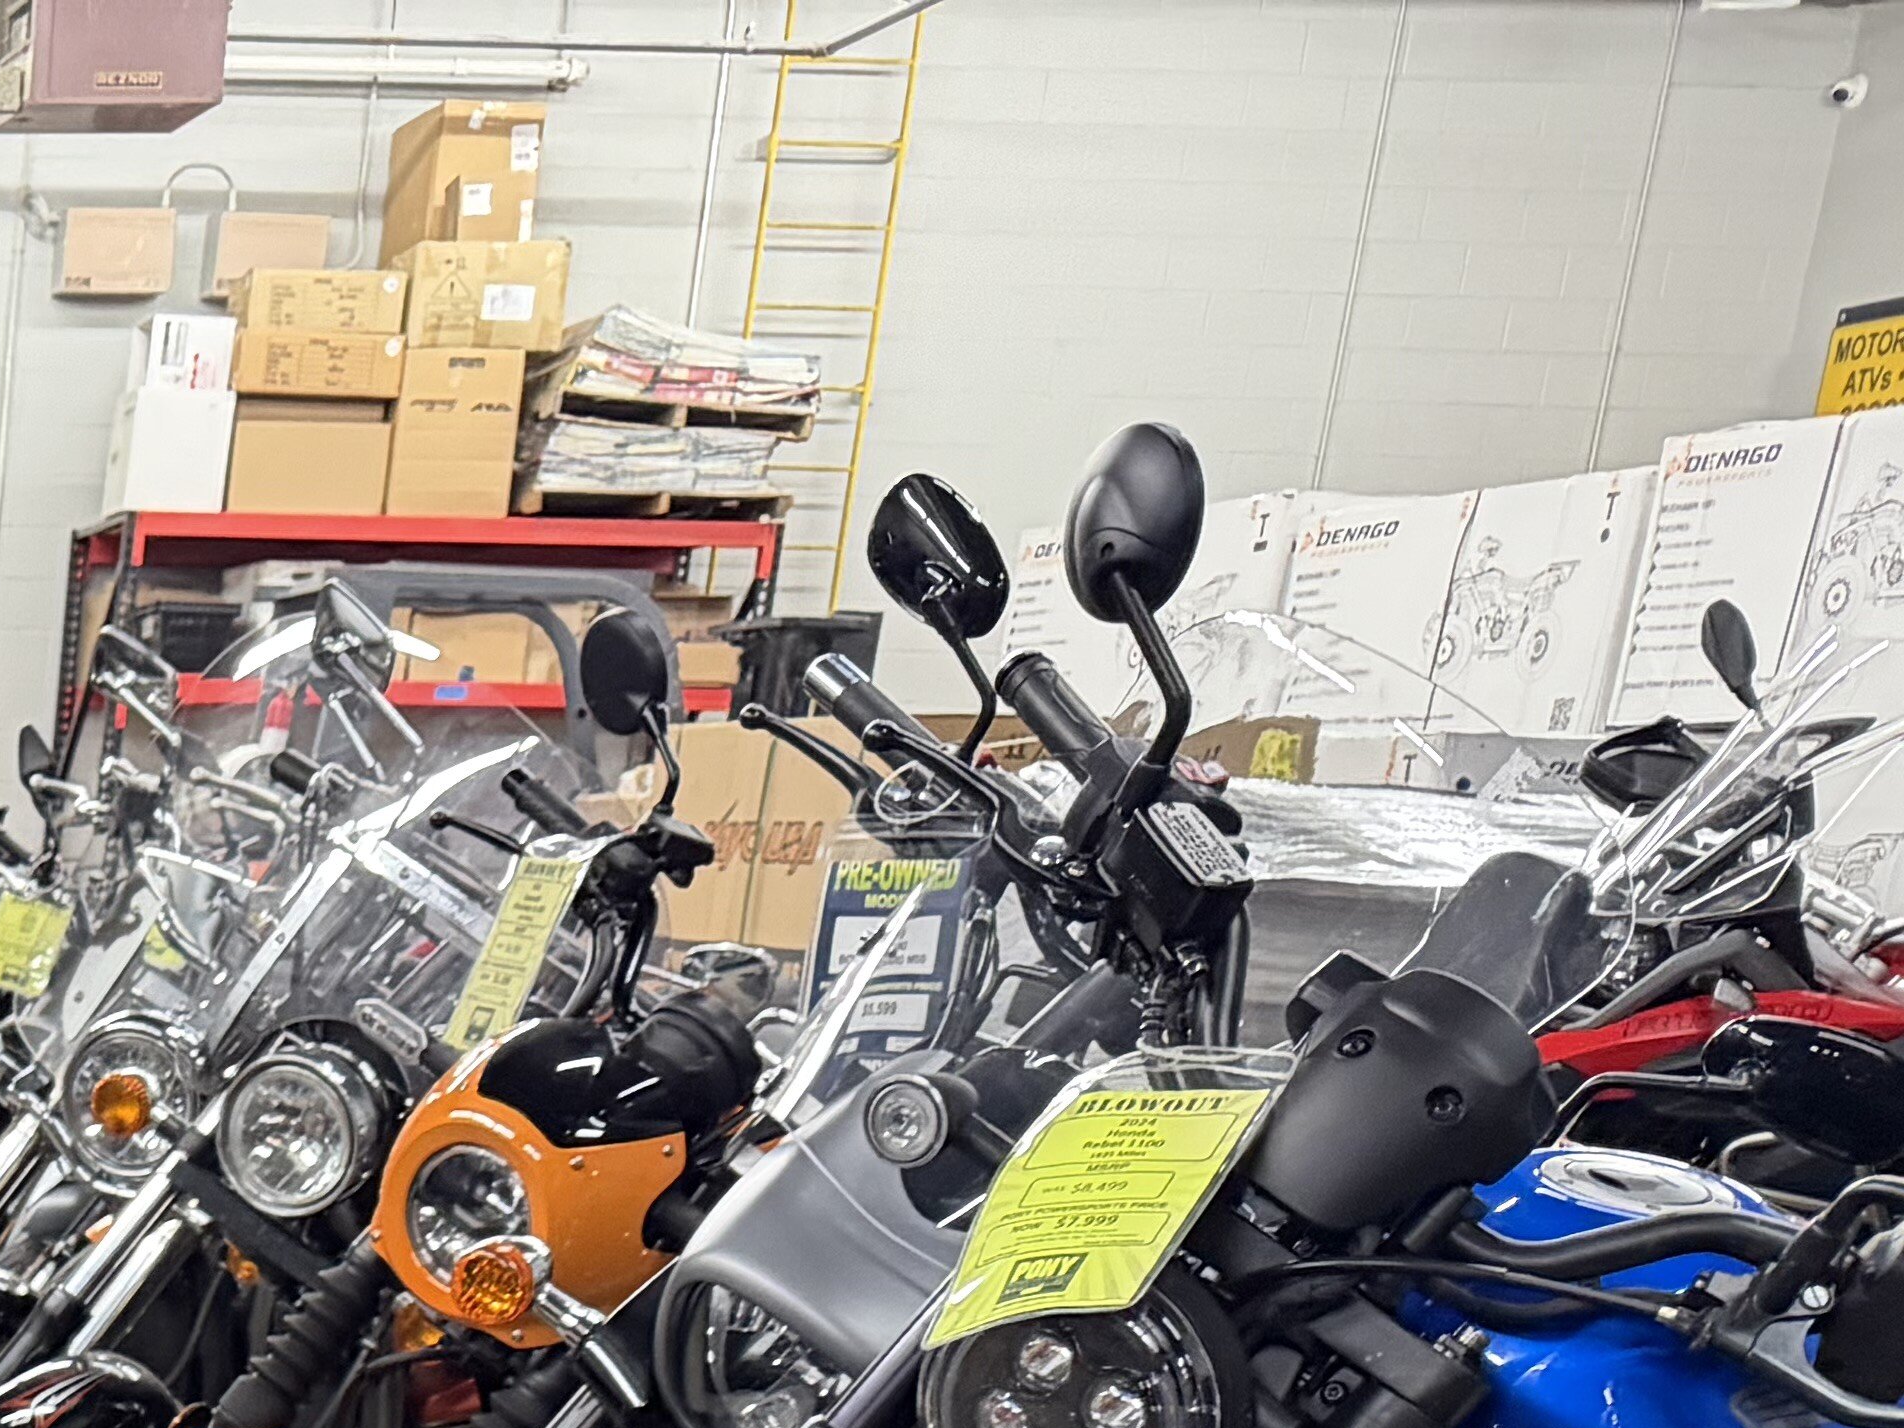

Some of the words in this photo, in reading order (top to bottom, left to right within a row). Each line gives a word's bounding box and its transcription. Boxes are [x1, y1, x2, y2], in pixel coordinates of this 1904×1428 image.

[1841, 365, 1891, 397] ATVs
[1683, 443, 1783, 473] DENAGO
[1316, 520, 1400, 547] DENAGO
[833, 859, 961, 892] PRE-OWNED
[1075, 1096, 1229, 1114] BLOWOUT
[1106, 1129, 1157, 1138] Honda
[1119, 1118, 1158, 1127] 2024
[1083, 1139, 1125, 1149] Rebel
[1128, 1139, 1166, 1148] 1100
[1035, 1202, 1128, 1215] POWERSPORTS
[1129, 1201, 1169, 1209] PRICE
[1010, 1256, 1081, 1283] PONY
